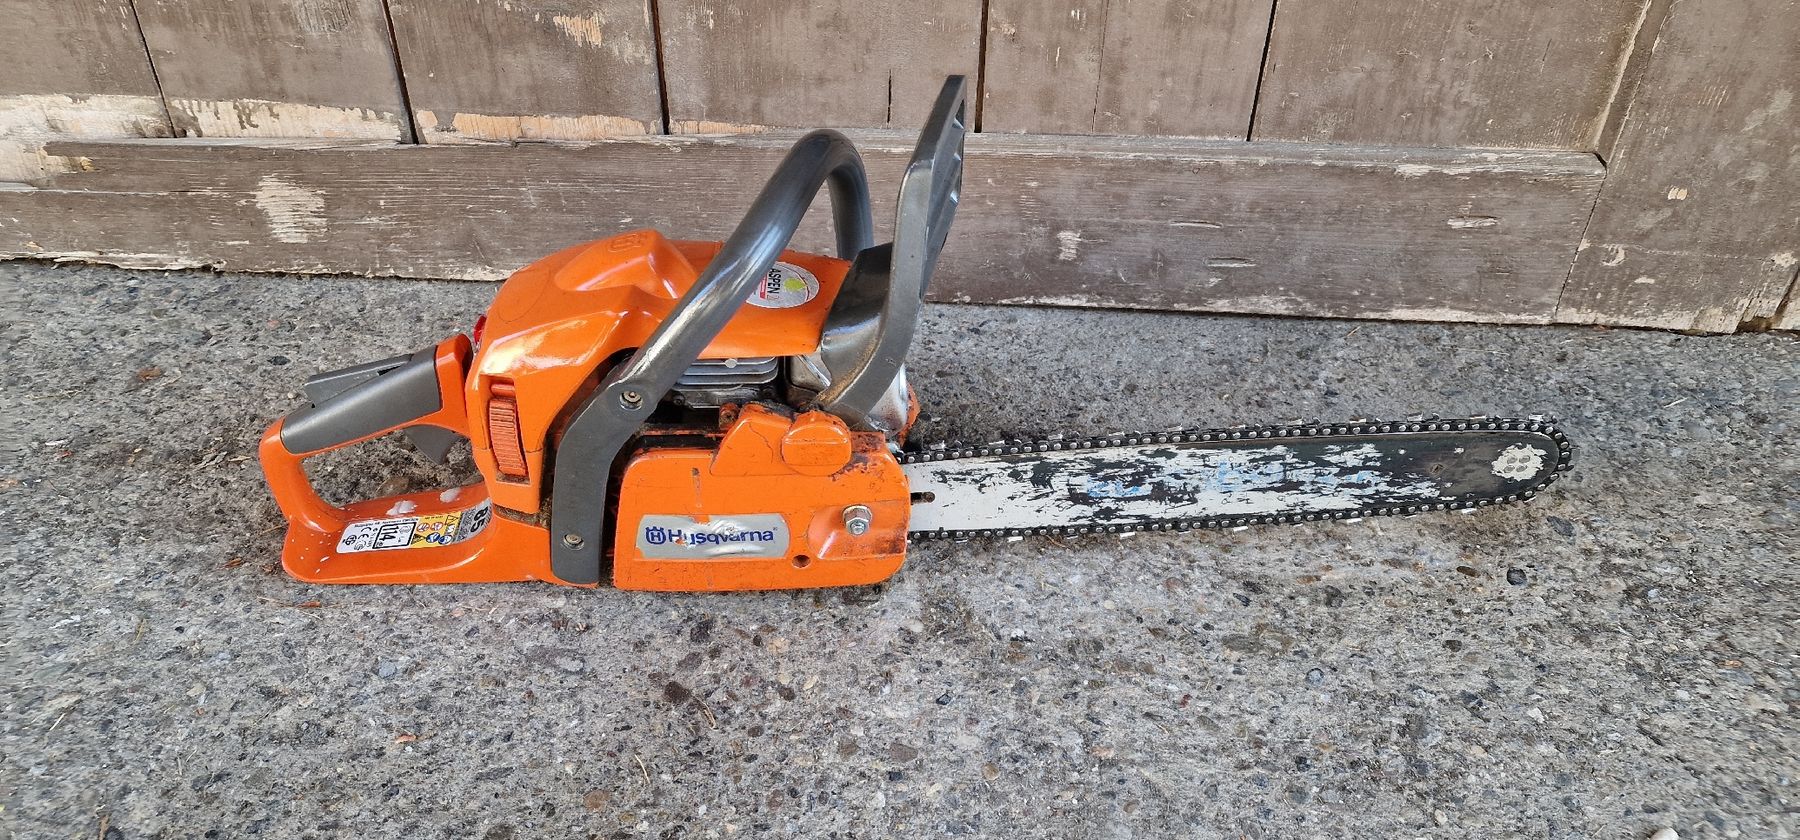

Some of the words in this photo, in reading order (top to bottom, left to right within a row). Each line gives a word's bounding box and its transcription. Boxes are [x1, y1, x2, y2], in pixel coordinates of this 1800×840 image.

[767, 268, 782, 294] ASPEN
[379, 525, 399, 541] 114
[668, 528, 774, 545] Husqvarna
